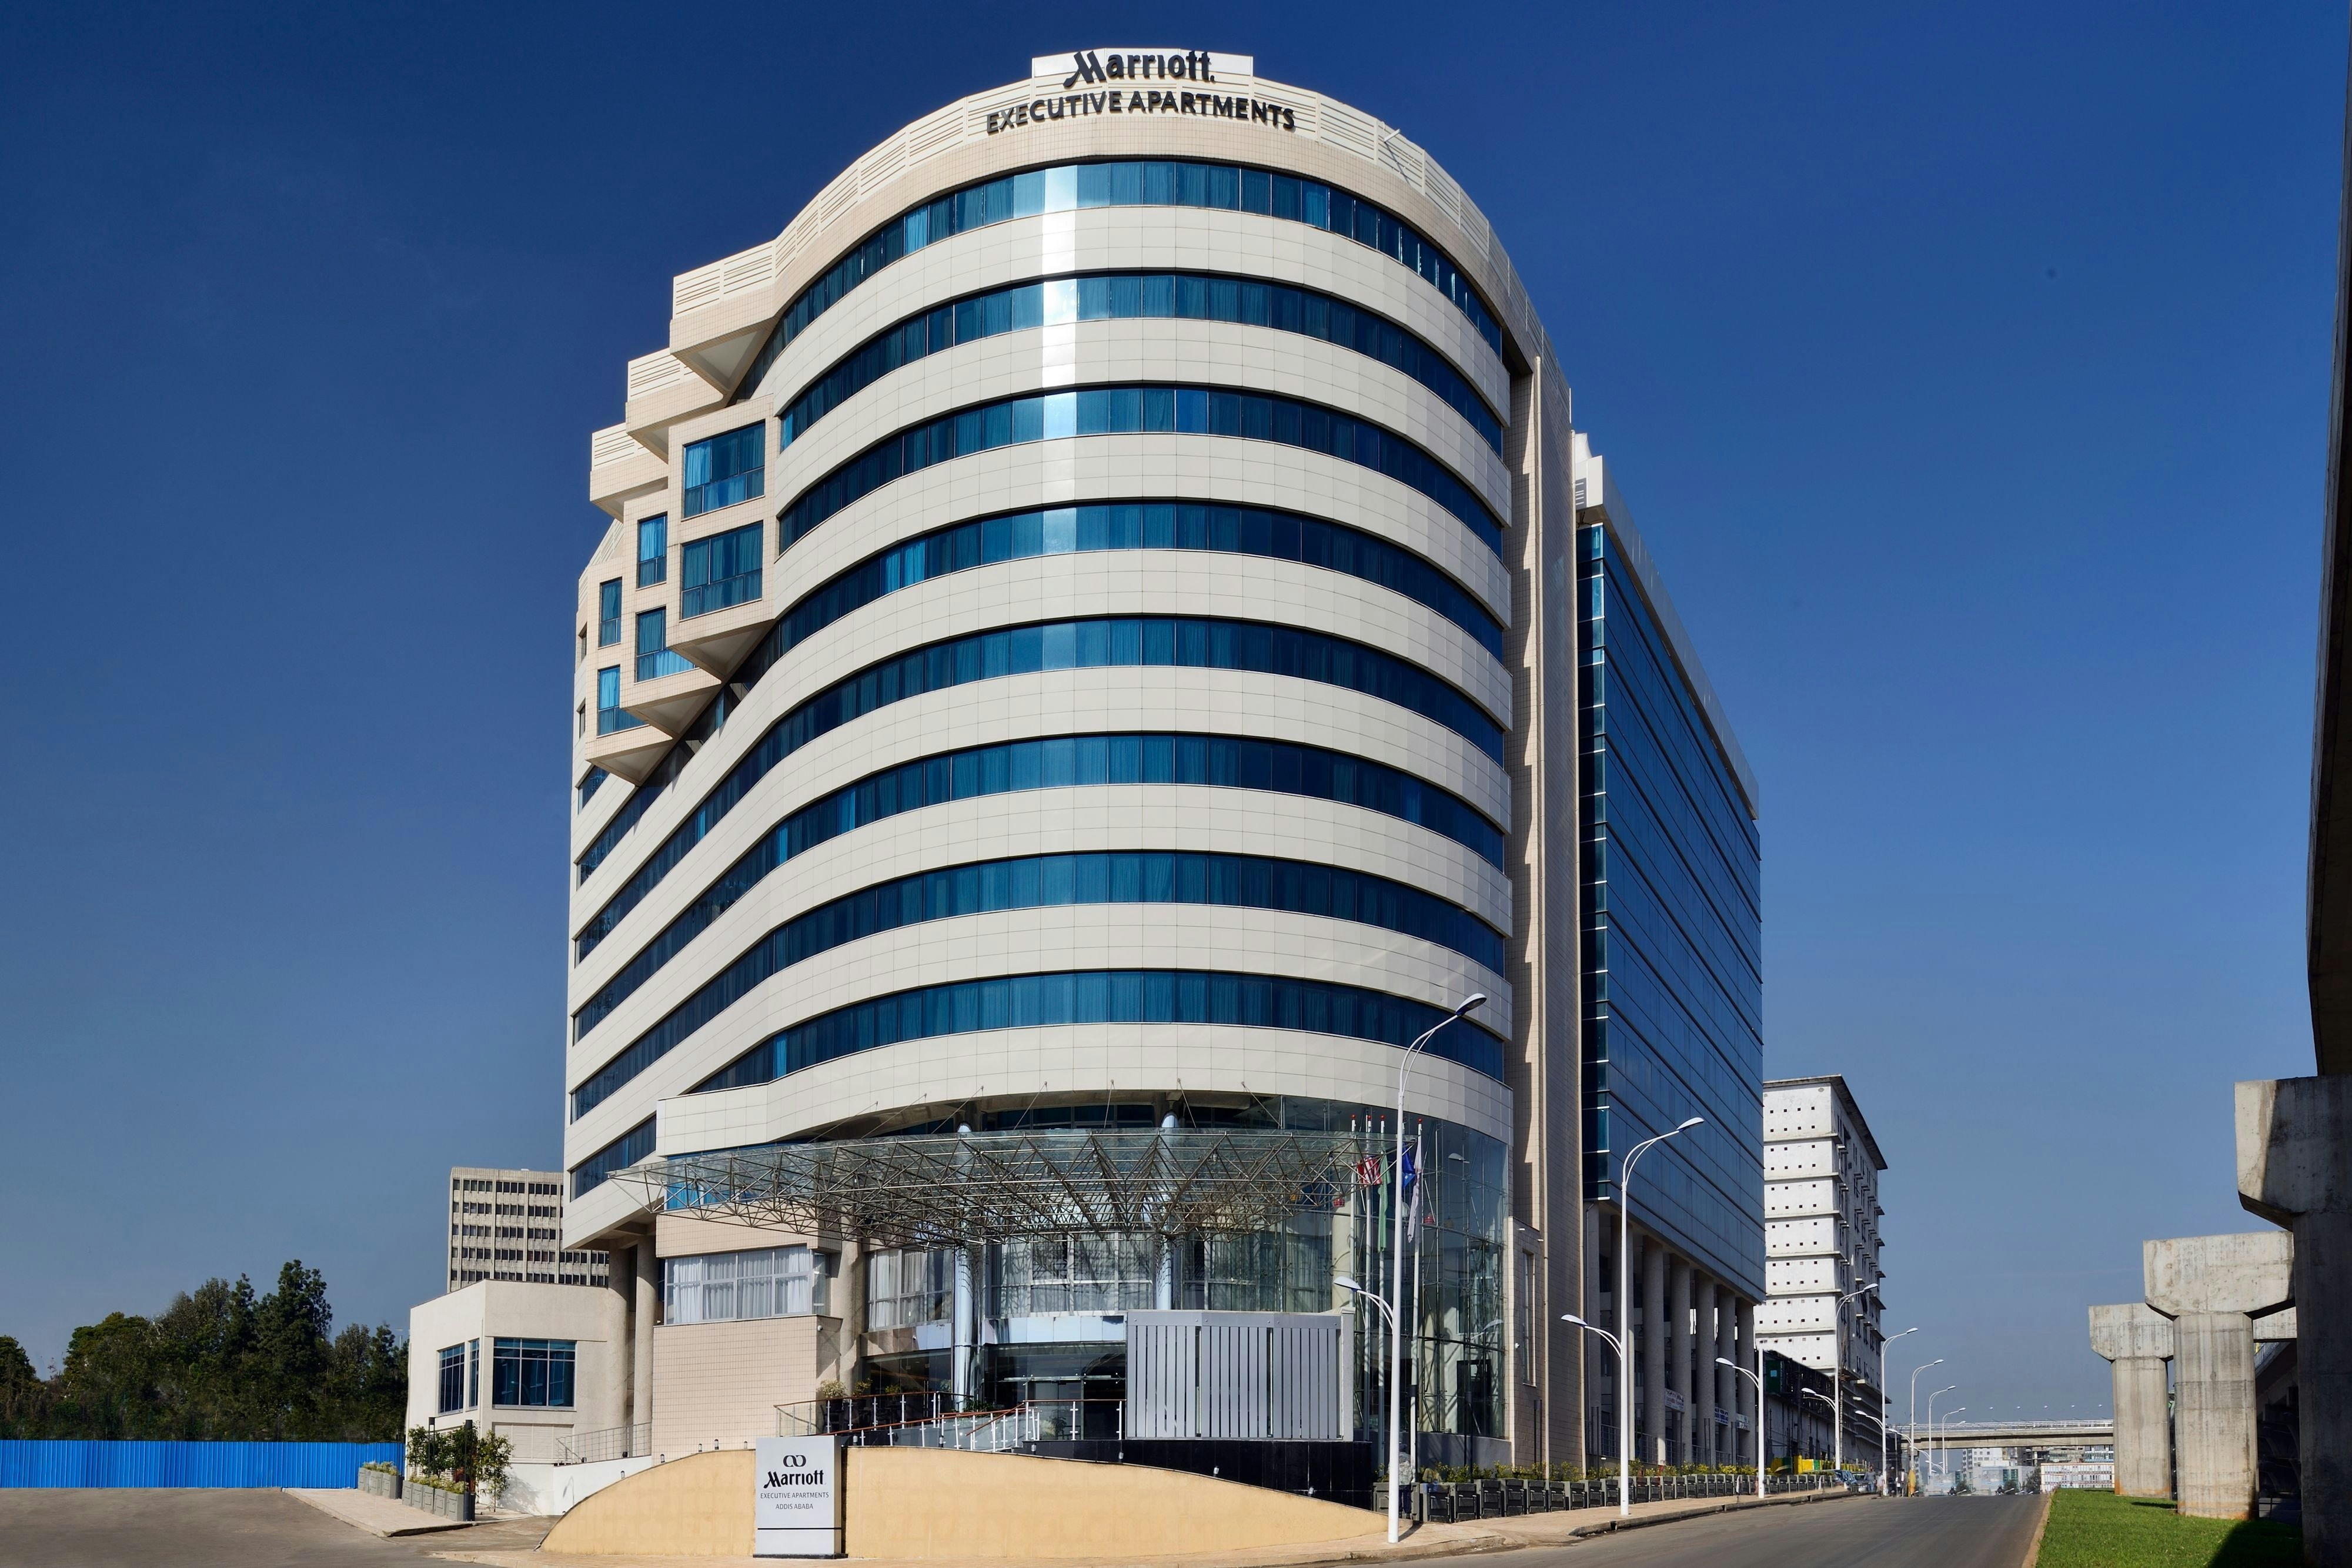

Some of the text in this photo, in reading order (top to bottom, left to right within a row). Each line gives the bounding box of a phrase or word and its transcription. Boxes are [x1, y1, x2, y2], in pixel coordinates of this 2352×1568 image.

[1063, 50, 1211, 88] Marriott
[986, 90, 1296, 135] EXECUTIVE APARTMENTS
[763, 1469, 824, 1489] Marriott
